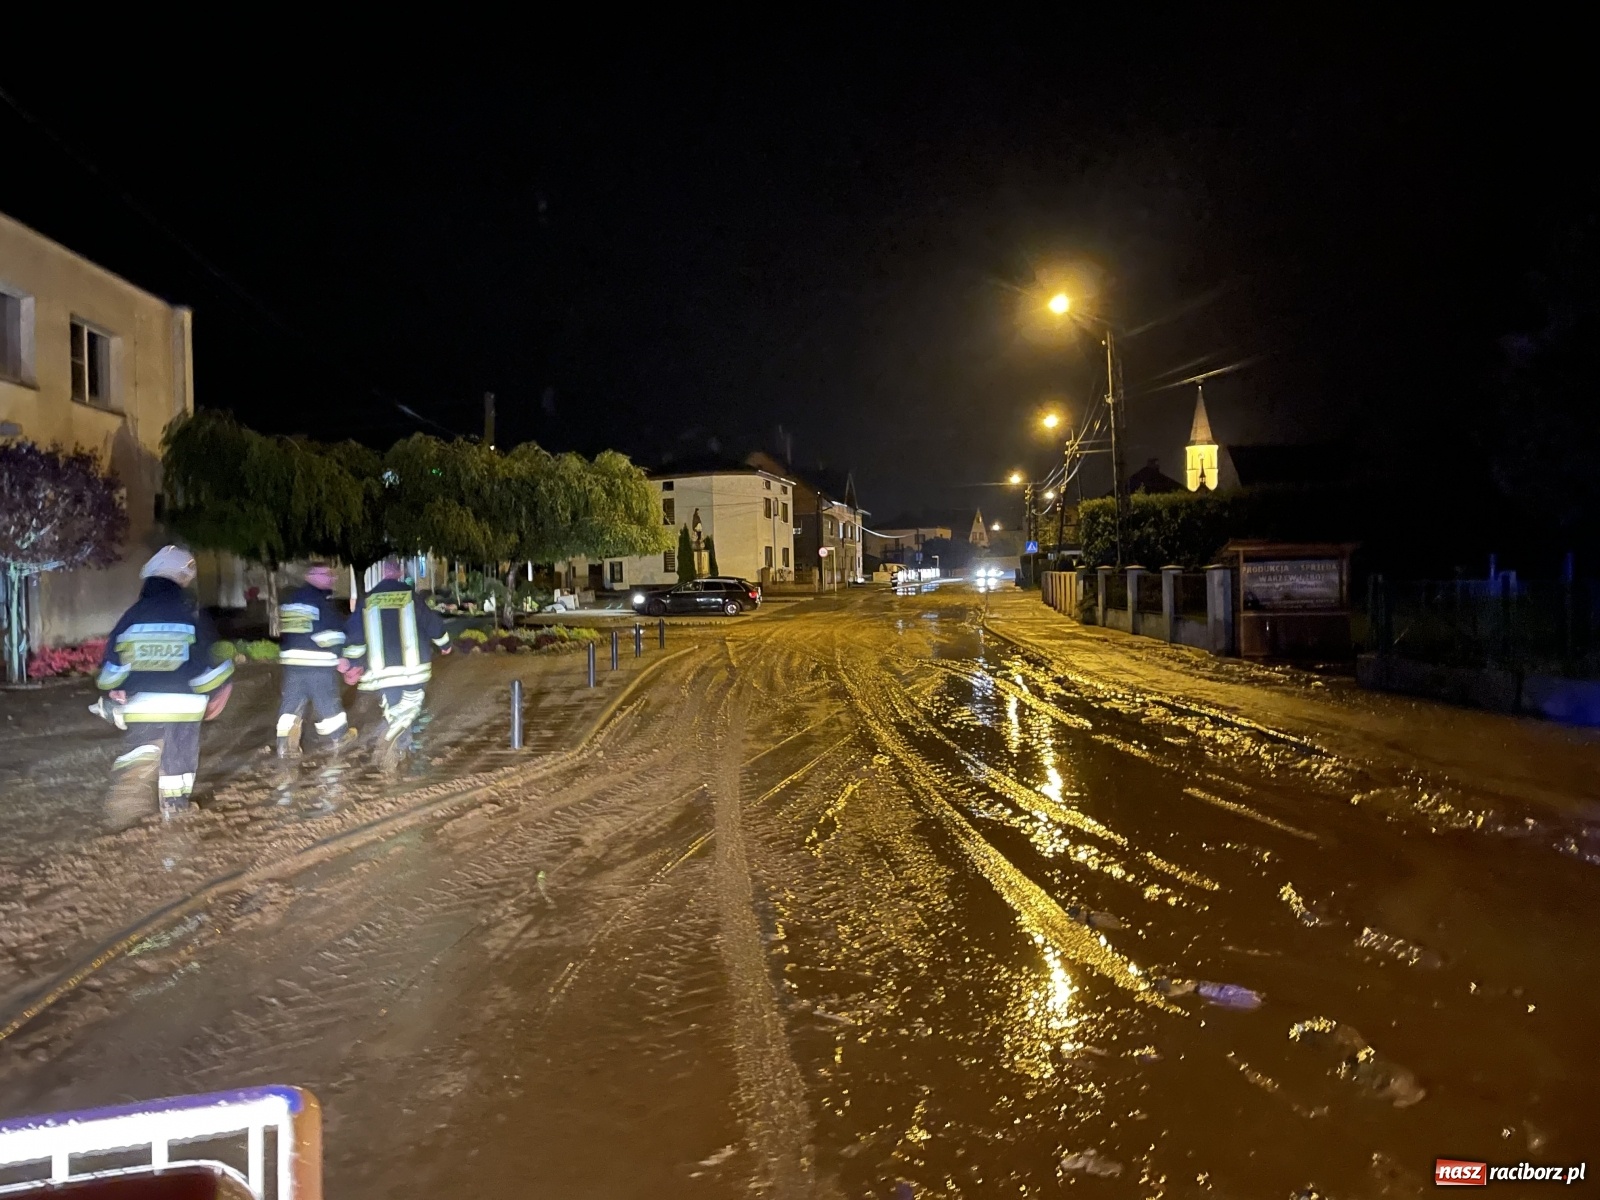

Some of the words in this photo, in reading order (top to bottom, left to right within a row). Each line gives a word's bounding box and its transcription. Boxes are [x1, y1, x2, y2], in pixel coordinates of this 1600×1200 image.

[1242, 565, 1290, 574] PRODUKCJA
[1300, 564, 1338, 572] SPRZEDA
[1259, 574, 1297, 583] WARZYW
